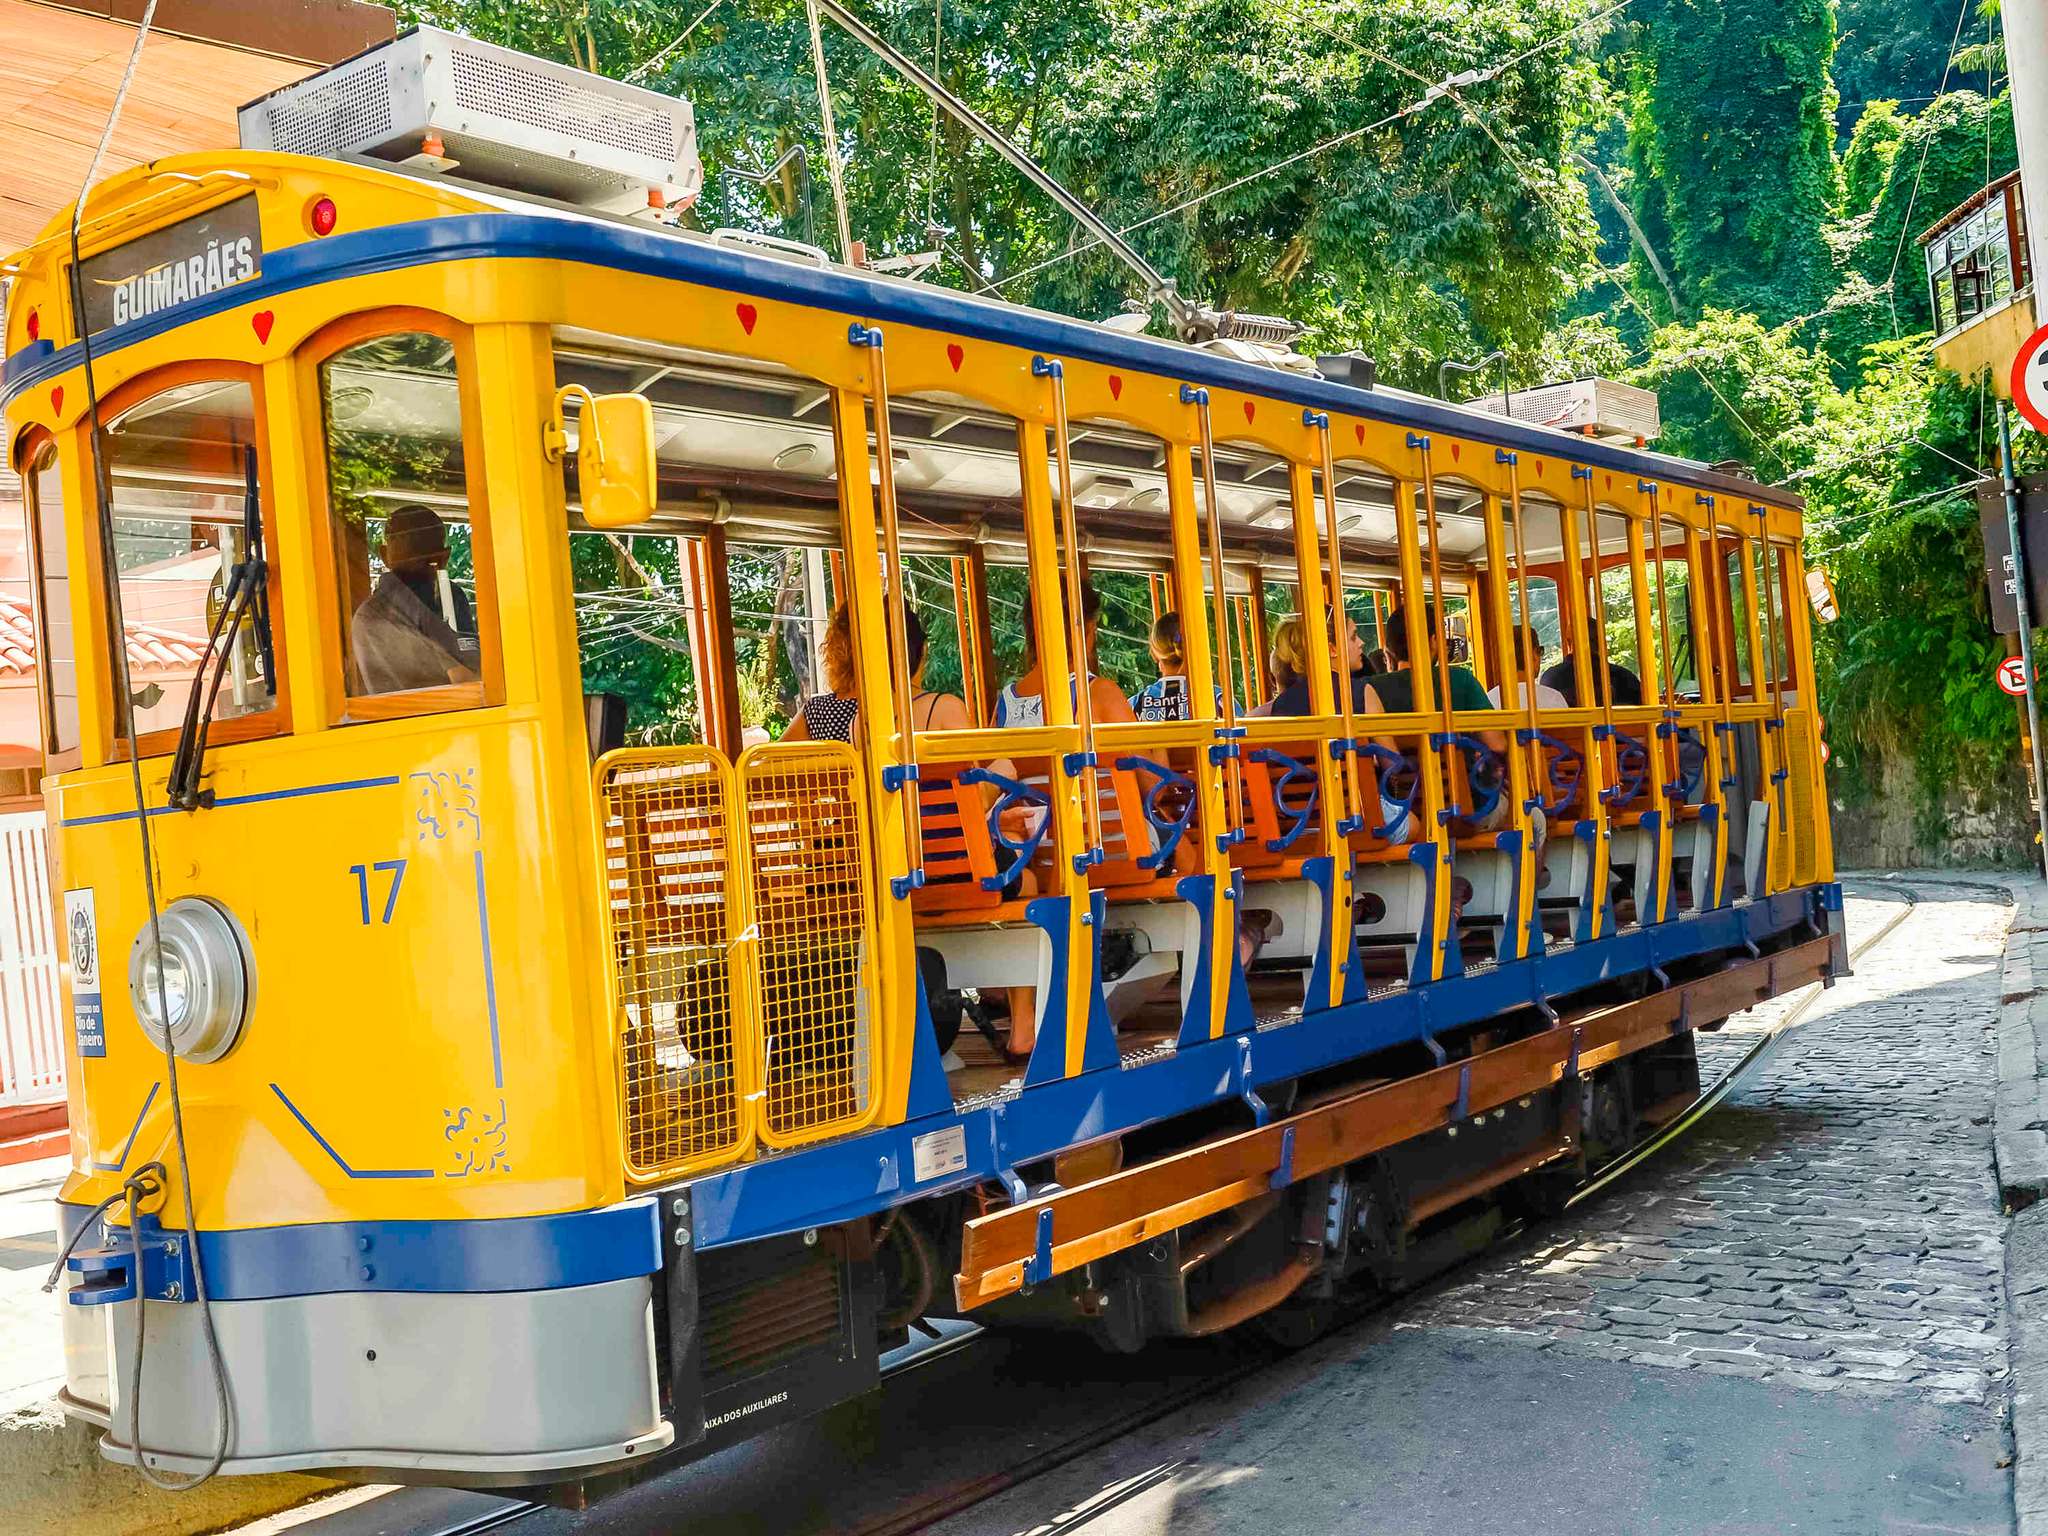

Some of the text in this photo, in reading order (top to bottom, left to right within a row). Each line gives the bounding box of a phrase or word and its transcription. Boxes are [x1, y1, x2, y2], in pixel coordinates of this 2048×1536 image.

[113, 236, 254, 326] GUIMARÃES
[349, 859, 408, 925] 17
[86, 1015, 96, 1030] de
[77, 1031, 103, 1047] Janeiro
[724, 1409, 742, 1423] DOS
[742, 1391, 788, 1417] AUXILIARES
